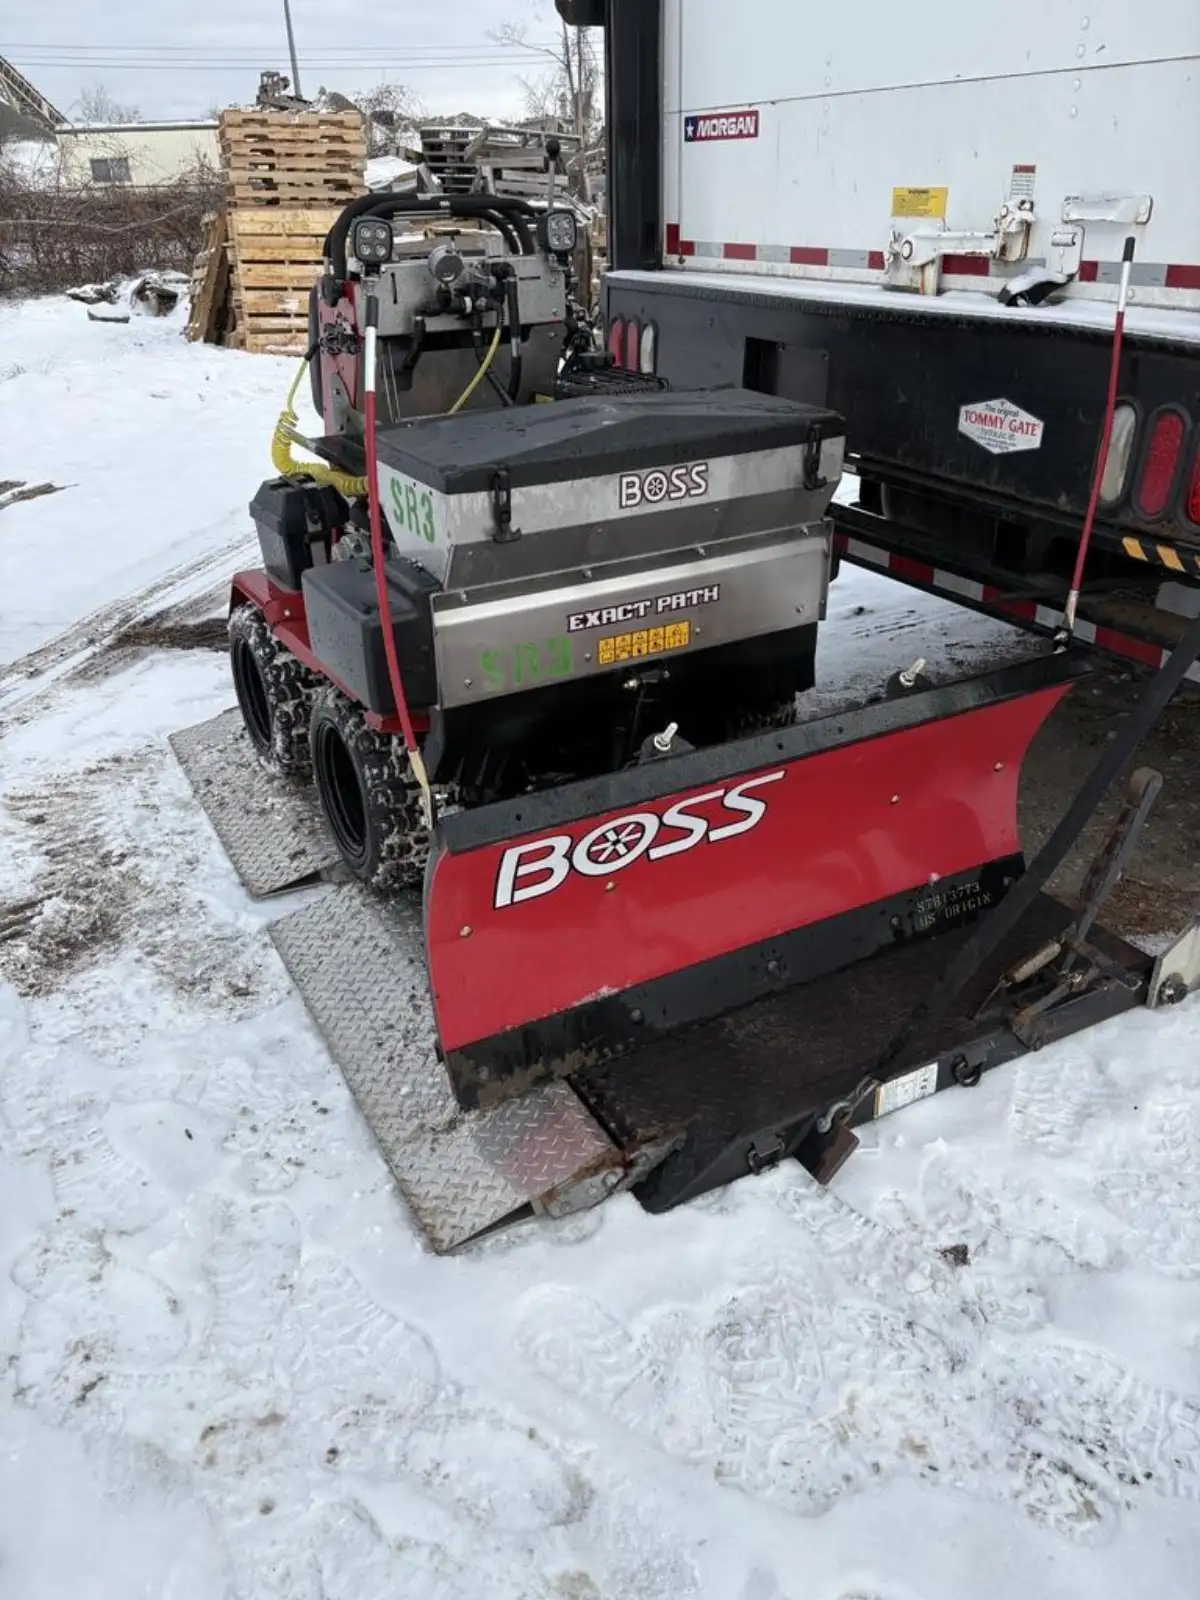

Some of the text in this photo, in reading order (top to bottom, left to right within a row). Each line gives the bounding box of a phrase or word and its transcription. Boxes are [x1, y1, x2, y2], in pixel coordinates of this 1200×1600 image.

[697, 116, 756, 137] MORGAN
[964, 411, 1005, 430] TOMMY
[1009, 419, 1038, 436] GATE
[390, 476, 435, 543] SR3
[620, 462, 708, 509] BOSS
[567, 584, 720, 632] EXACT PATH
[481, 637, 572, 691] SR3
[493, 769, 786, 909] BOSS
